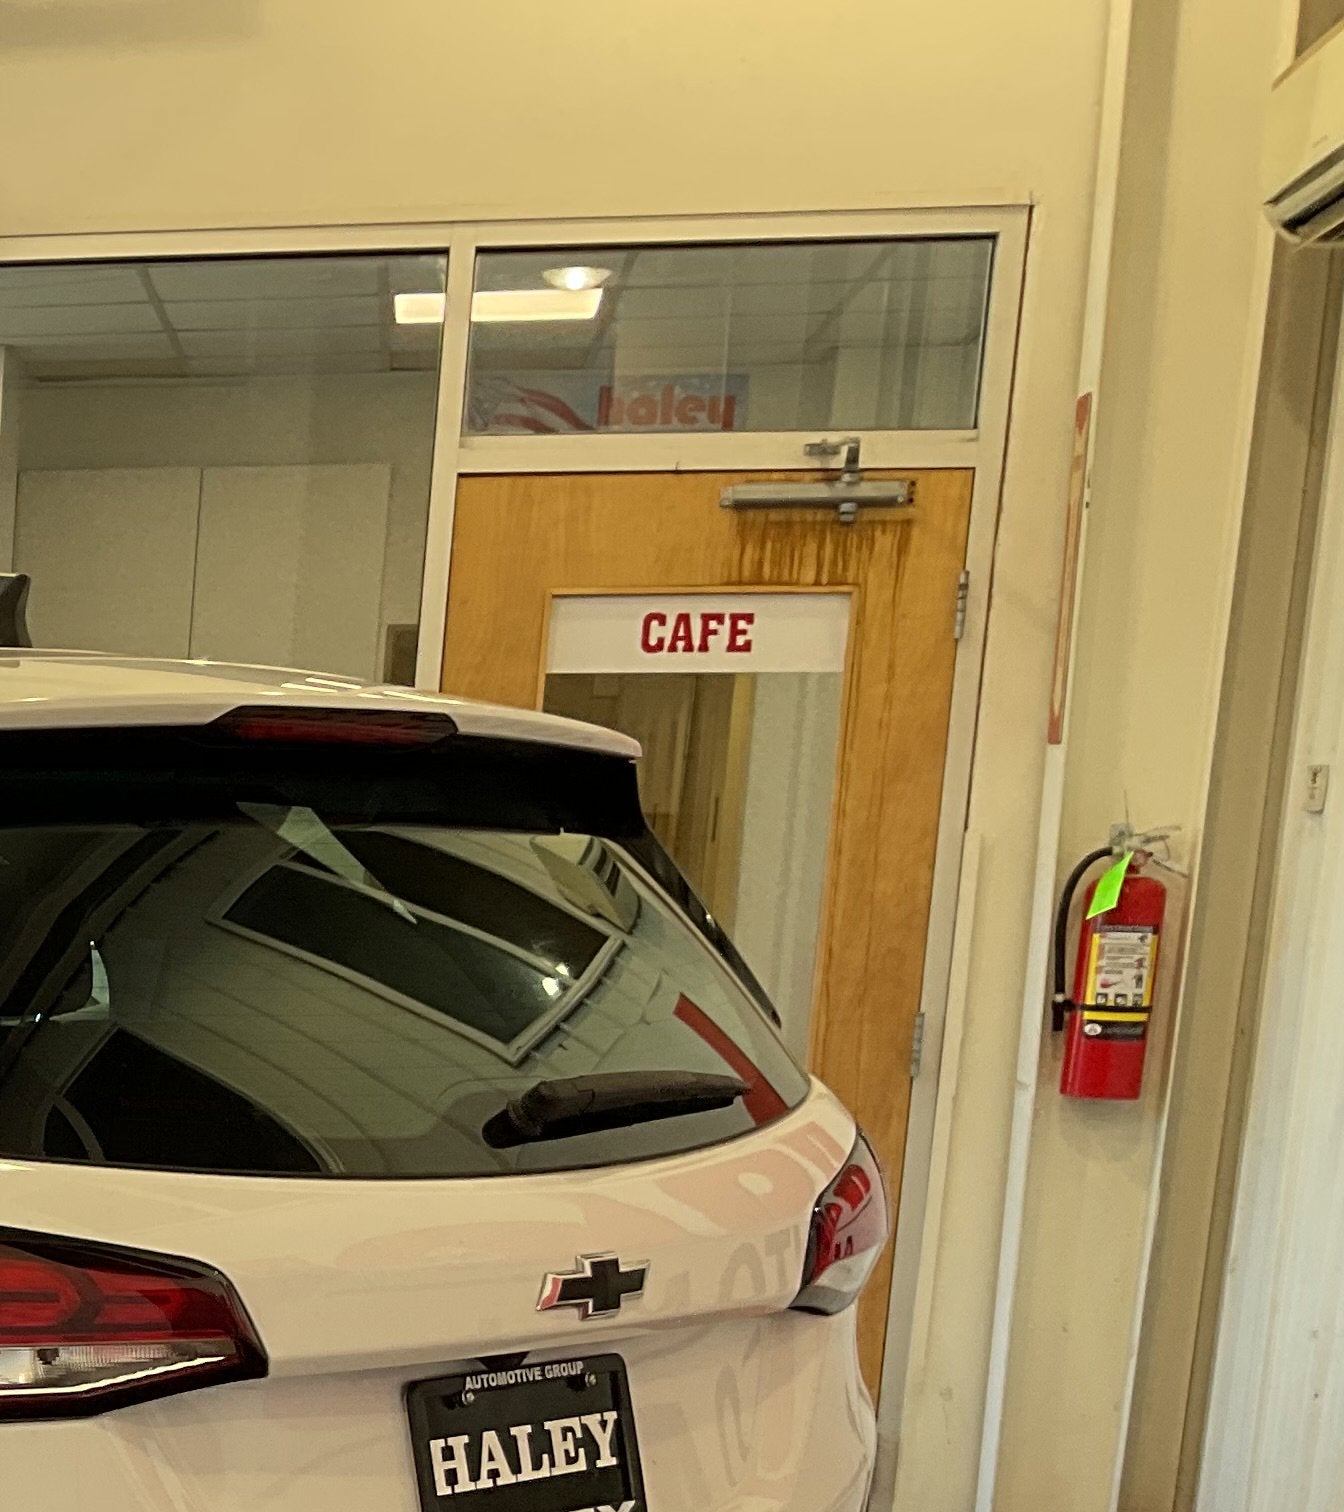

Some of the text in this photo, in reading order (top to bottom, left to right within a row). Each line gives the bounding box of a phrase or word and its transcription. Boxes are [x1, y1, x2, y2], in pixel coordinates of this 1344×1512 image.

[597, 384, 737, 431] haley
[640, 612, 756, 654] CAFE
[464, 1361, 584, 1391] AUTOMOTIVE GROUP
[429, 1411, 619, 1496] HALEY
